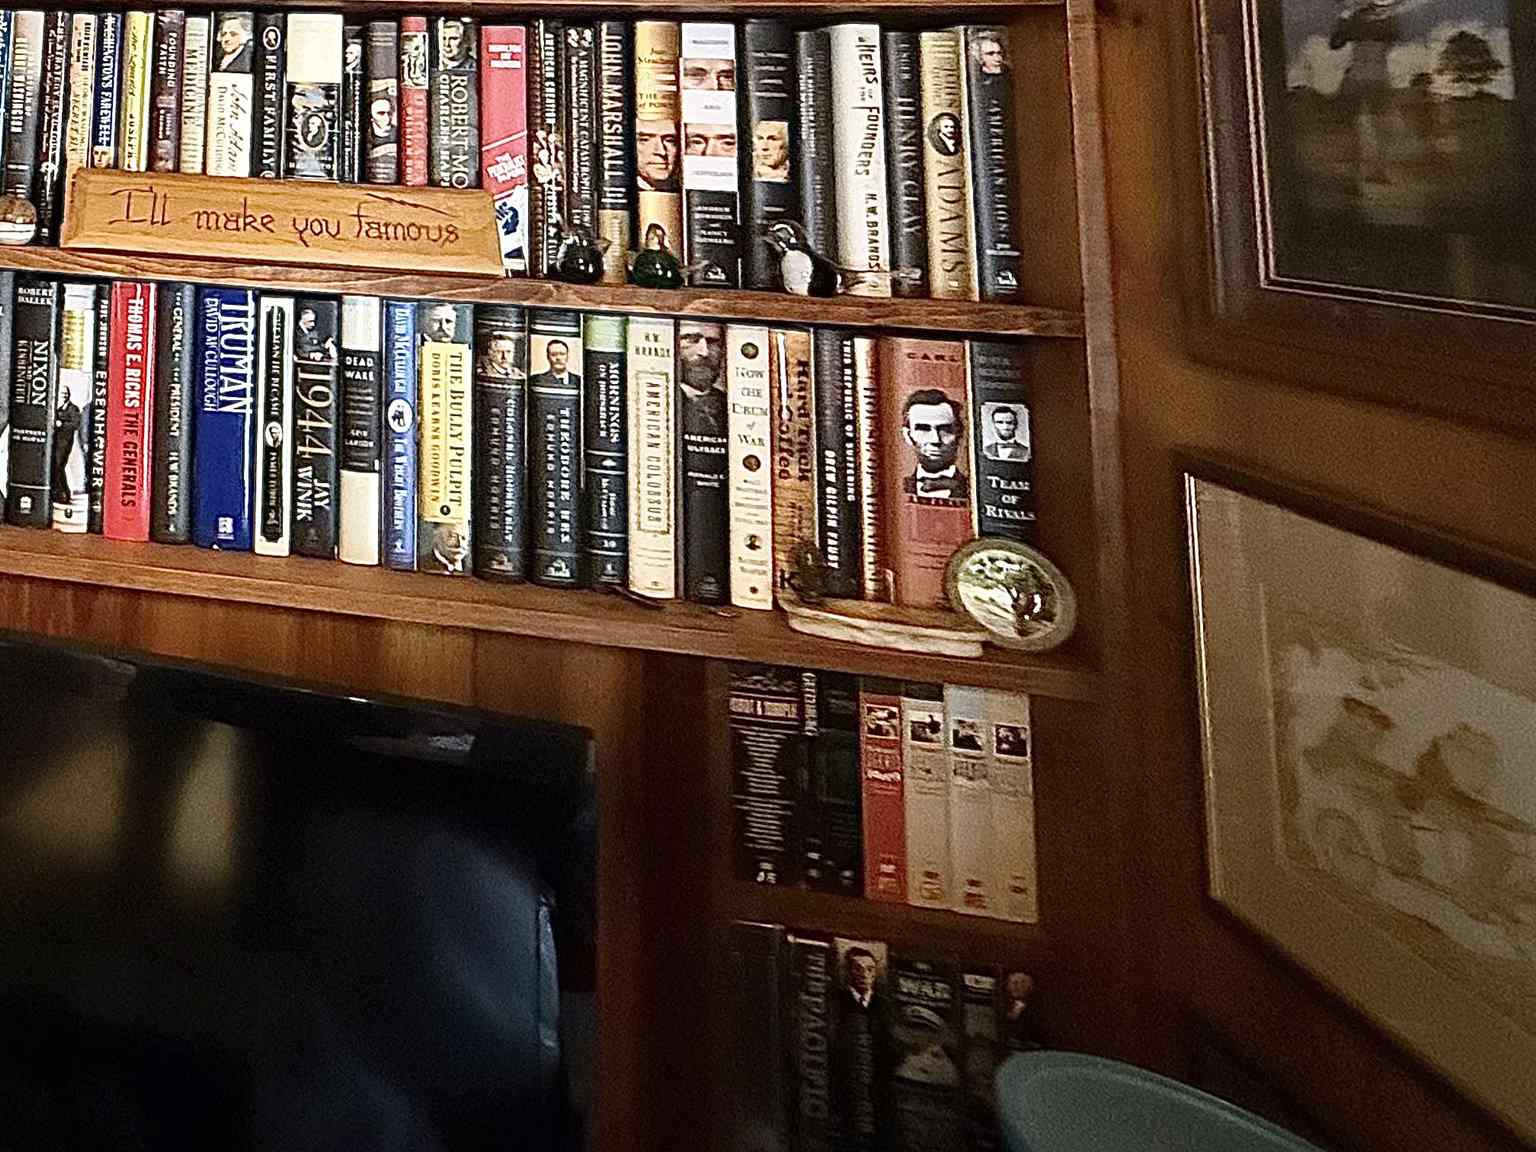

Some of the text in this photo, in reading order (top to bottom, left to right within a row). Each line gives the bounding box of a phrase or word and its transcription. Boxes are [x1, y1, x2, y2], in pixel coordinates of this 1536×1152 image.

[166, 32, 177, 87] FOUNDING
[183, 48, 198, 125] MEDICINE
[544, 33, 555, 77] AMERICAN
[261, 54, 278, 167] FIRST FAMILY
[450, 76, 469, 150] ROBERT
[601, 34, 625, 180] JOHN MARSHALL
[852, 43, 881, 270] HEIRS FOUNDERS BRANDS
[894, 96, 921, 235] HENRY CLAY
[193, 198, 459, 247] make you famous
[937, 161, 965, 274] ADAMS
[17, 295, 54, 306] DALLEK
[18, 286, 54, 298] ROBERT
[205, 297, 219, 332] DAVID
[172, 307, 183, 352] GENERAL
[218, 302, 253, 414] TRUMAN
[345, 356, 374, 368] DEAD
[31, 340, 49, 407] NIXON
[121, 297, 144, 507] THOMAS E. RICKS THE GENERALS
[345, 370, 374, 382] WAKE
[608, 361, 621, 443] MORNINGS
[735, 366, 765, 379] NOW
[741, 386, 763, 398] THE
[92, 370, 108, 488] EISENHOWER
[296, 366, 334, 511] 1944 JAY
[430, 352, 442, 503] DORIS KEARNS GOODWIN
[449, 352, 465, 507] THE BULLY PULPIT
[489, 407, 501, 466] EDMUND
[732, 403, 768, 416] DRUM
[738, 433, 765, 448] WAR
[843, 339, 855, 502] THIS REPUBLIC OF SUFFERING
[503, 398, 516, 543] COLONEL ROOSEVELT
[545, 413, 556, 535] EDMUND MORRIS
[559, 407, 571, 544] THEODORE REX
[645, 382, 662, 523] AMERICAN COLOSSUS
[986, 475, 1031, 491] TEAM
[296, 465, 313, 522] WINIK
[393, 489, 407, 531] BROTHERS
[825, 450, 840, 569] DREW GILPIN FAUST
[984, 505, 1037, 521] RIVALS
[1001, 494, 1021, 505] OF
